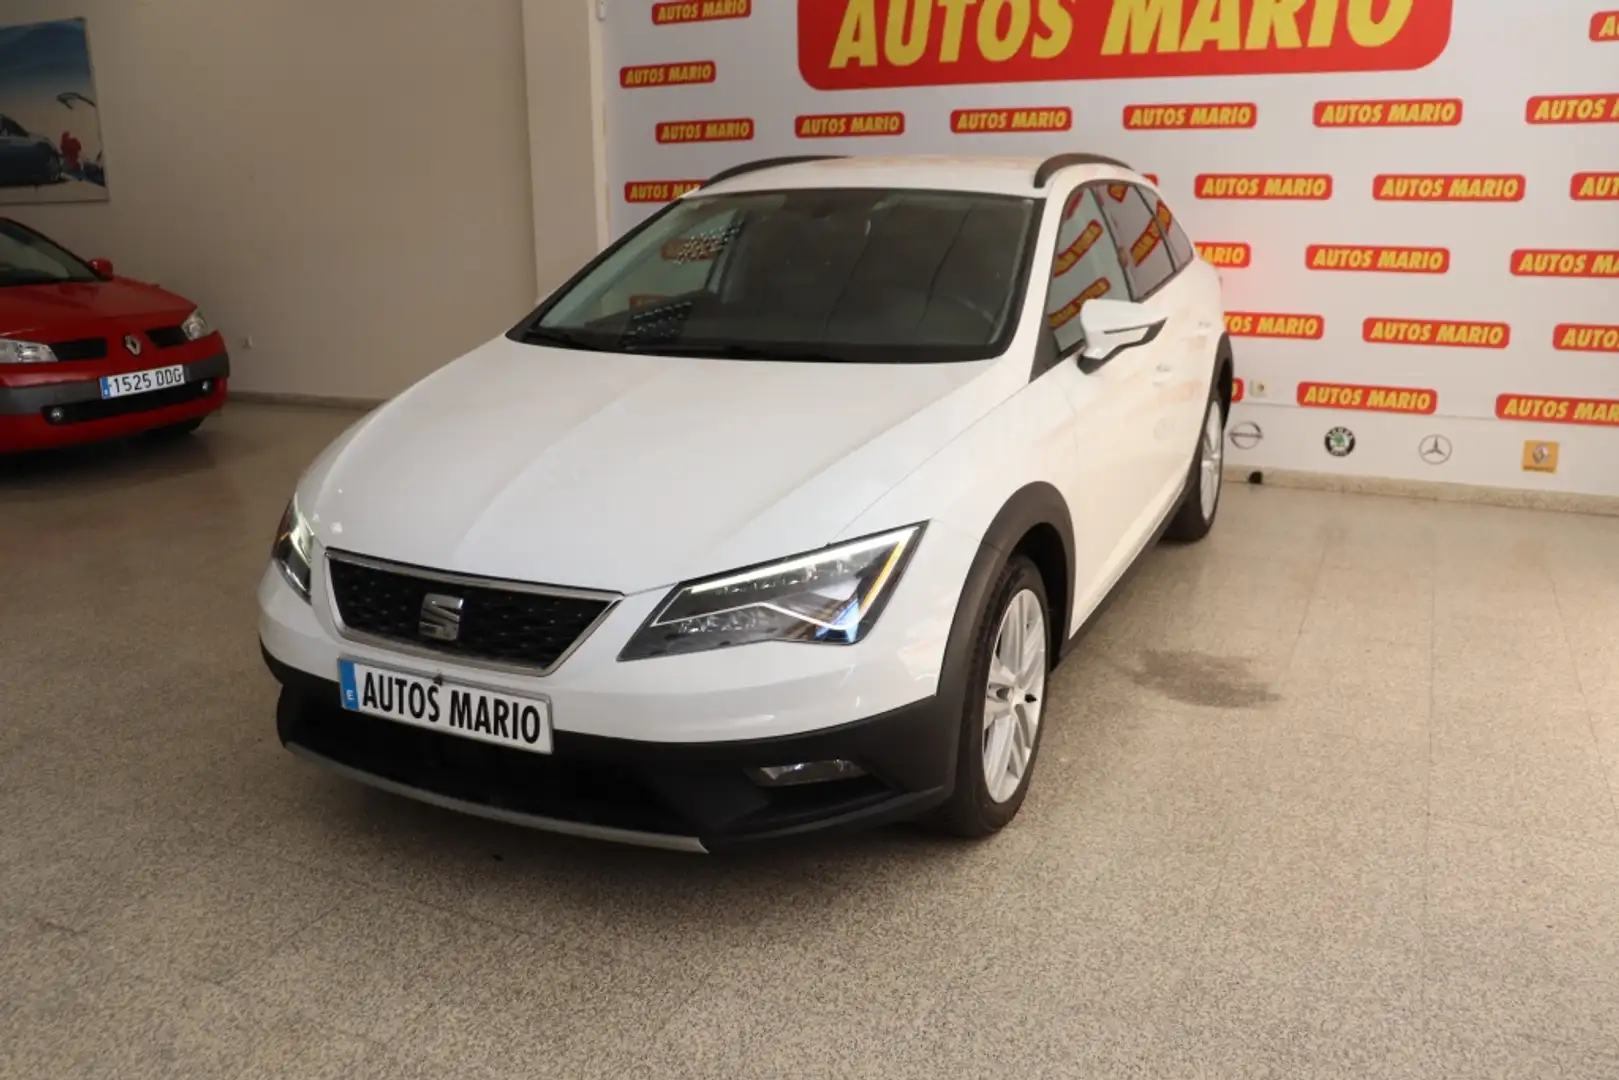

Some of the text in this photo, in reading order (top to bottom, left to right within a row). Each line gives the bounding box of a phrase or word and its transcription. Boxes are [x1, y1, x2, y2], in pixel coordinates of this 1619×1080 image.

[658, 0, 747, 21] AUTOS MARIO
[828, 0, 1414, 69] AUTOS MARIO
[626, 65, 711, 84] AUTOS MARIO
[1131, 106, 1251, 126] AUTOS MARIO
[1322, 103, 1457, 124] AUTOS MARIO
[1535, 100, 1606, 120] AUTOS
[802, 116, 900, 134] AUTOS MARIO
[958, 111, 1067, 130] AUTOS MARIO
[662, 122, 749, 140] AUTOS MARIO
[630, 184, 668, 200] AUTOS
[1203, 179, 1326, 196] AUTOS MARIO
[1381, 178, 1518, 198] AUTOS MARIO
[1313, 249, 1444, 269] AUTOS MARIO
[1519, 254, 1586, 274] AUTOS
[1257, 317, 1318, 335] MARIO
[1371, 322, 1504, 344] AUTOS MARIO
[114, 373, 152, 393] 1525
[1304, 386, 1431, 410] AUTOS MARIO
[1504, 399, 1569, 419] AUTOS
[362, 671, 541, 745] AUTOS MARIO
